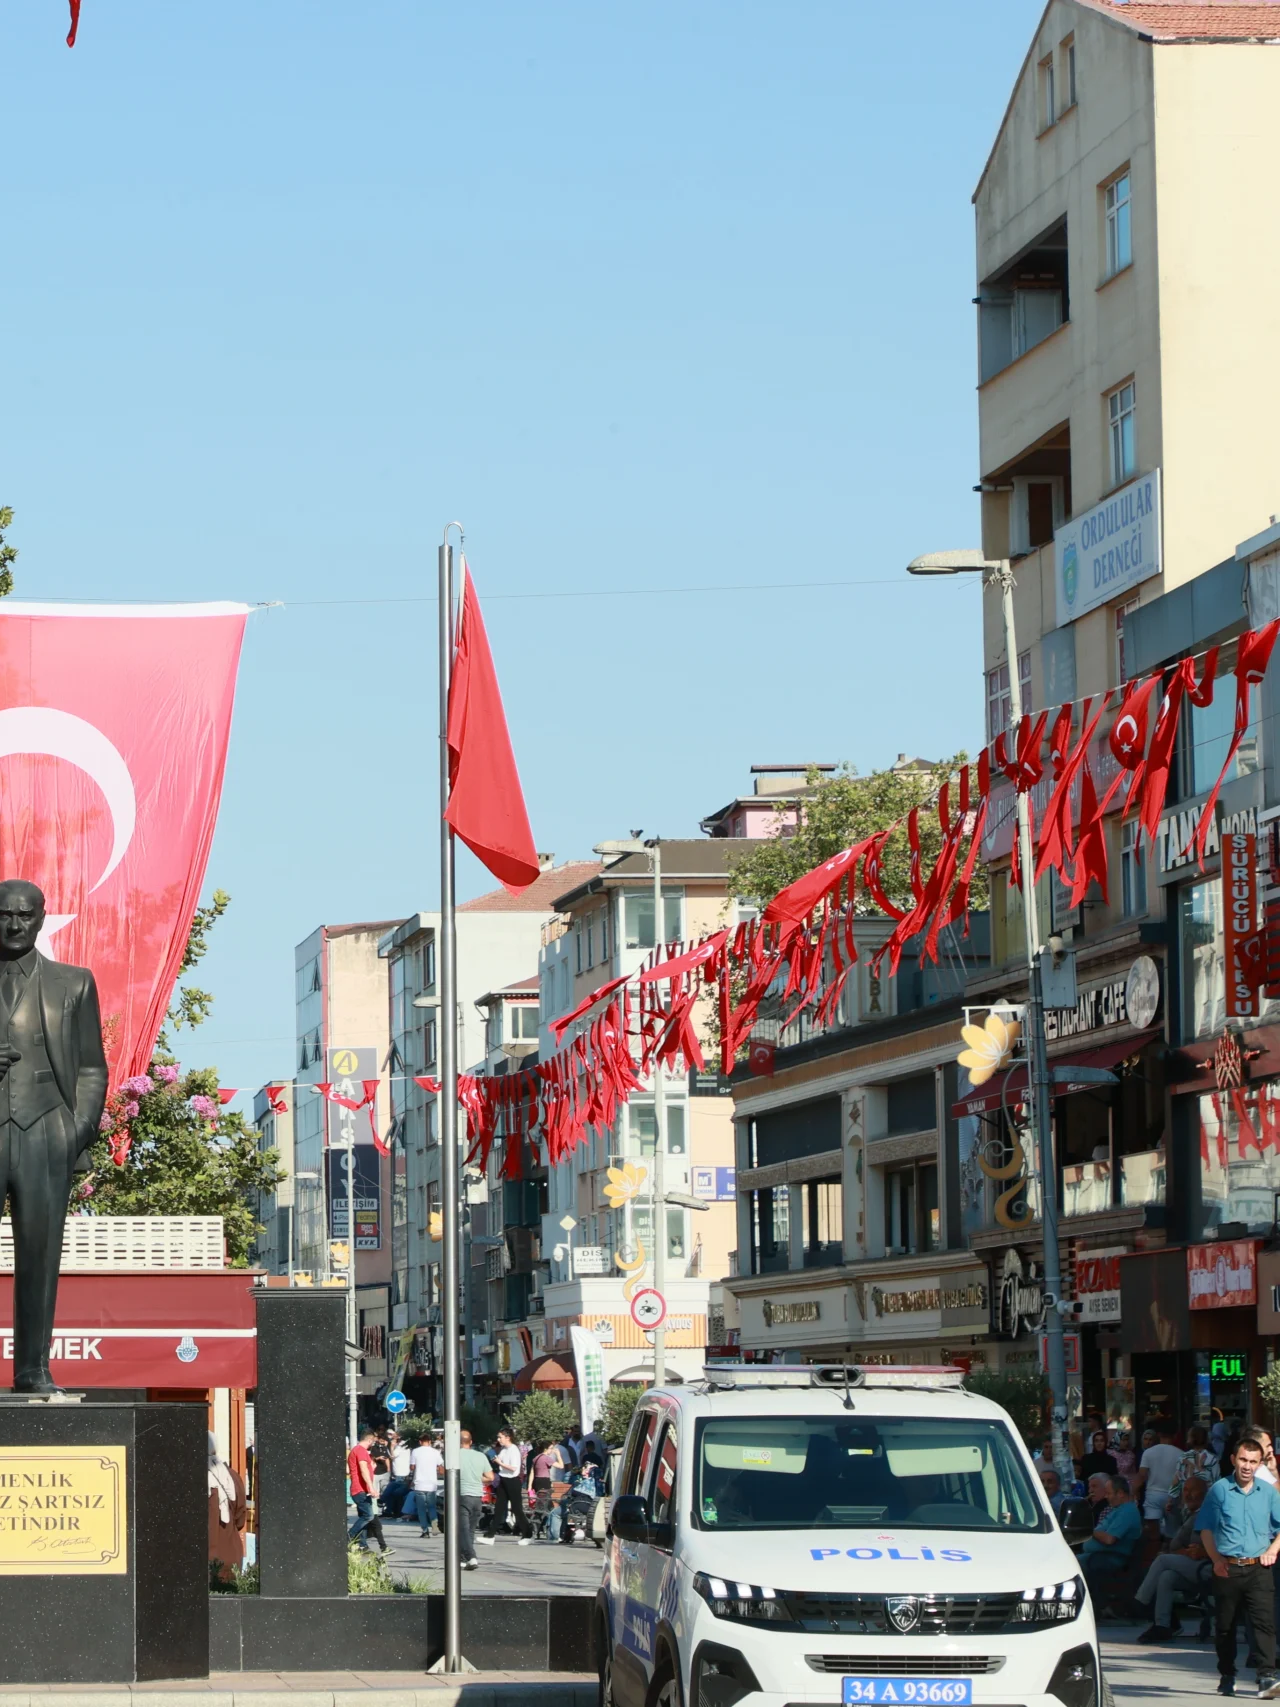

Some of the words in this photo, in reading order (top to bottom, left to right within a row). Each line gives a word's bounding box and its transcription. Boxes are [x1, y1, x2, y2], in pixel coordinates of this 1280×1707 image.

[1081, 482, 1153, 551] ORDULULAR
[1093, 523, 1142, 589] DERNEĞİ
[1231, 834, 1250, 933] SÜRÜCÜ
[1100, 980, 1126, 1026] CAFE
[335, 1197, 376, 1210] İLEİŞİM
[3, 1337, 103, 1360] EMEK
[1211, 1359, 1246, 1377] FUL
[18, 1494, 106, 1513] ŞARTSIZ
[810, 1545, 973, 1563] POLİS
[850, 1681, 875, 1701] 34
[880, 1682, 899, 1701] A
[903, 1682, 967, 1702] 93669
